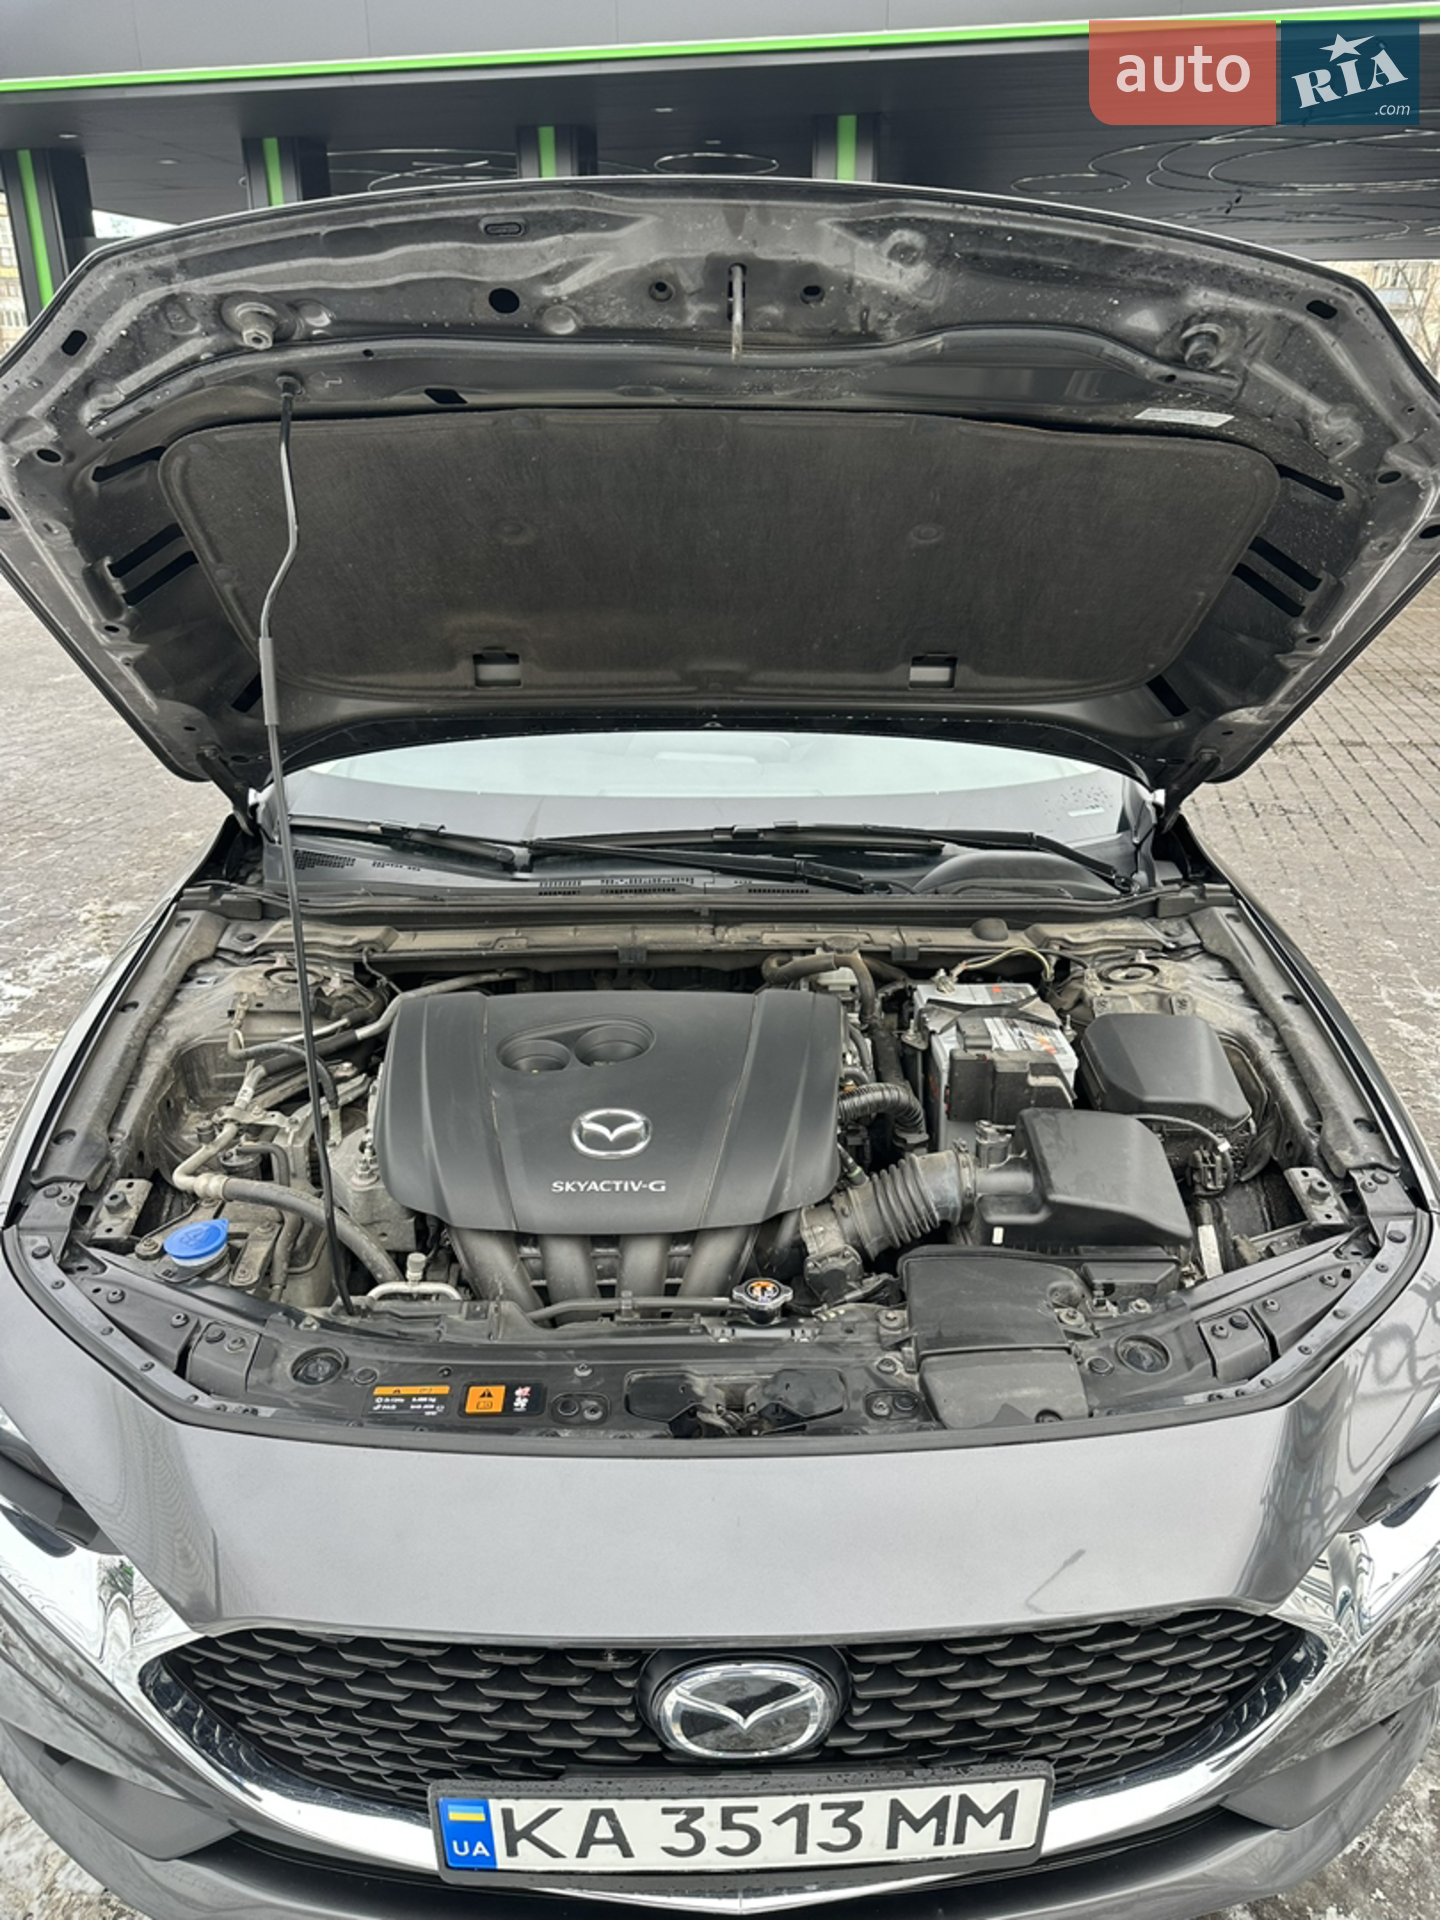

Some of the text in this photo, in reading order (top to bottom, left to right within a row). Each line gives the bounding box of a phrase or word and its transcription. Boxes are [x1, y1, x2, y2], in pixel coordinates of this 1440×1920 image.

[551, 1180, 666, 1192] SKYACTIV-G
[500, 1788, 1020, 1859] KA 3513 MM
[452, 1839, 491, 1857] UA
